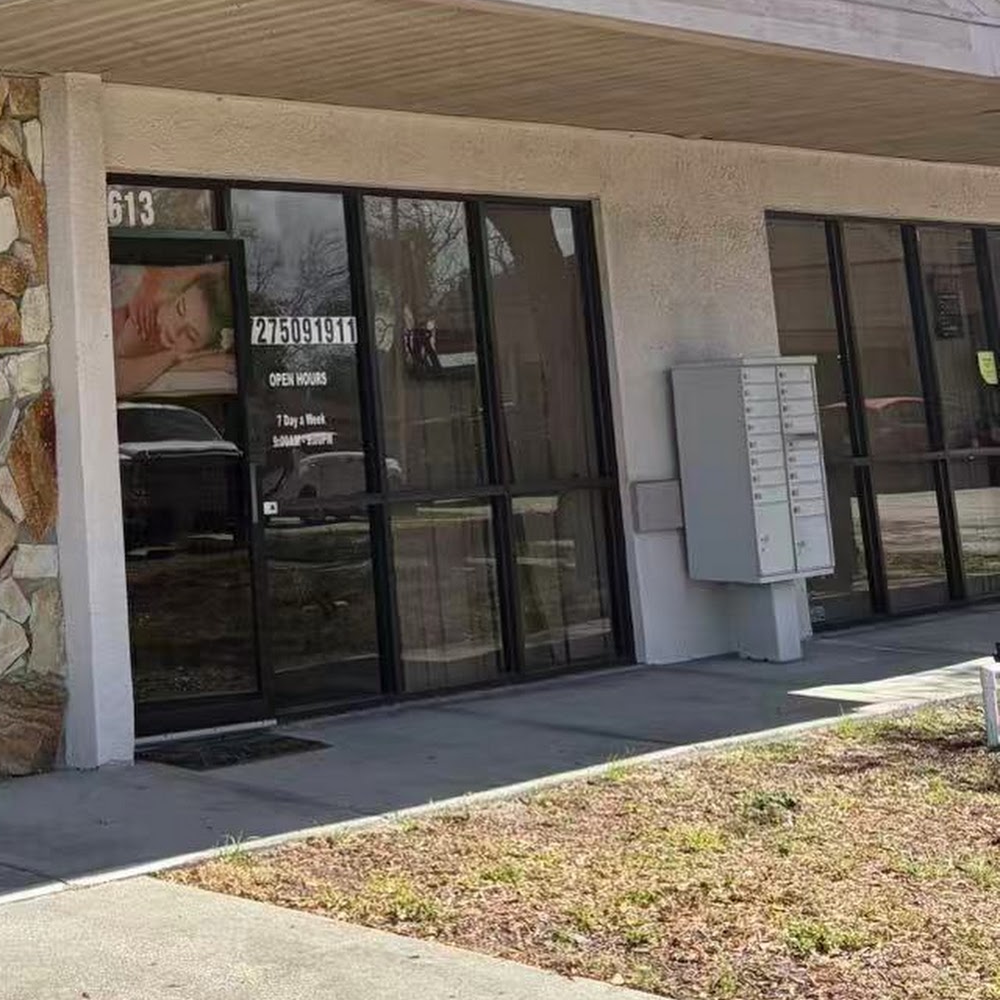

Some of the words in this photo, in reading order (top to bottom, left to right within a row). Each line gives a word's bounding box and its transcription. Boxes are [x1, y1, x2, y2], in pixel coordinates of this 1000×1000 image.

[107, 189, 156, 227] 613
[269, 372, 295, 387] OPEN
[296, 371, 327, 386] HOURS
[283, 413, 298, 429] Day
